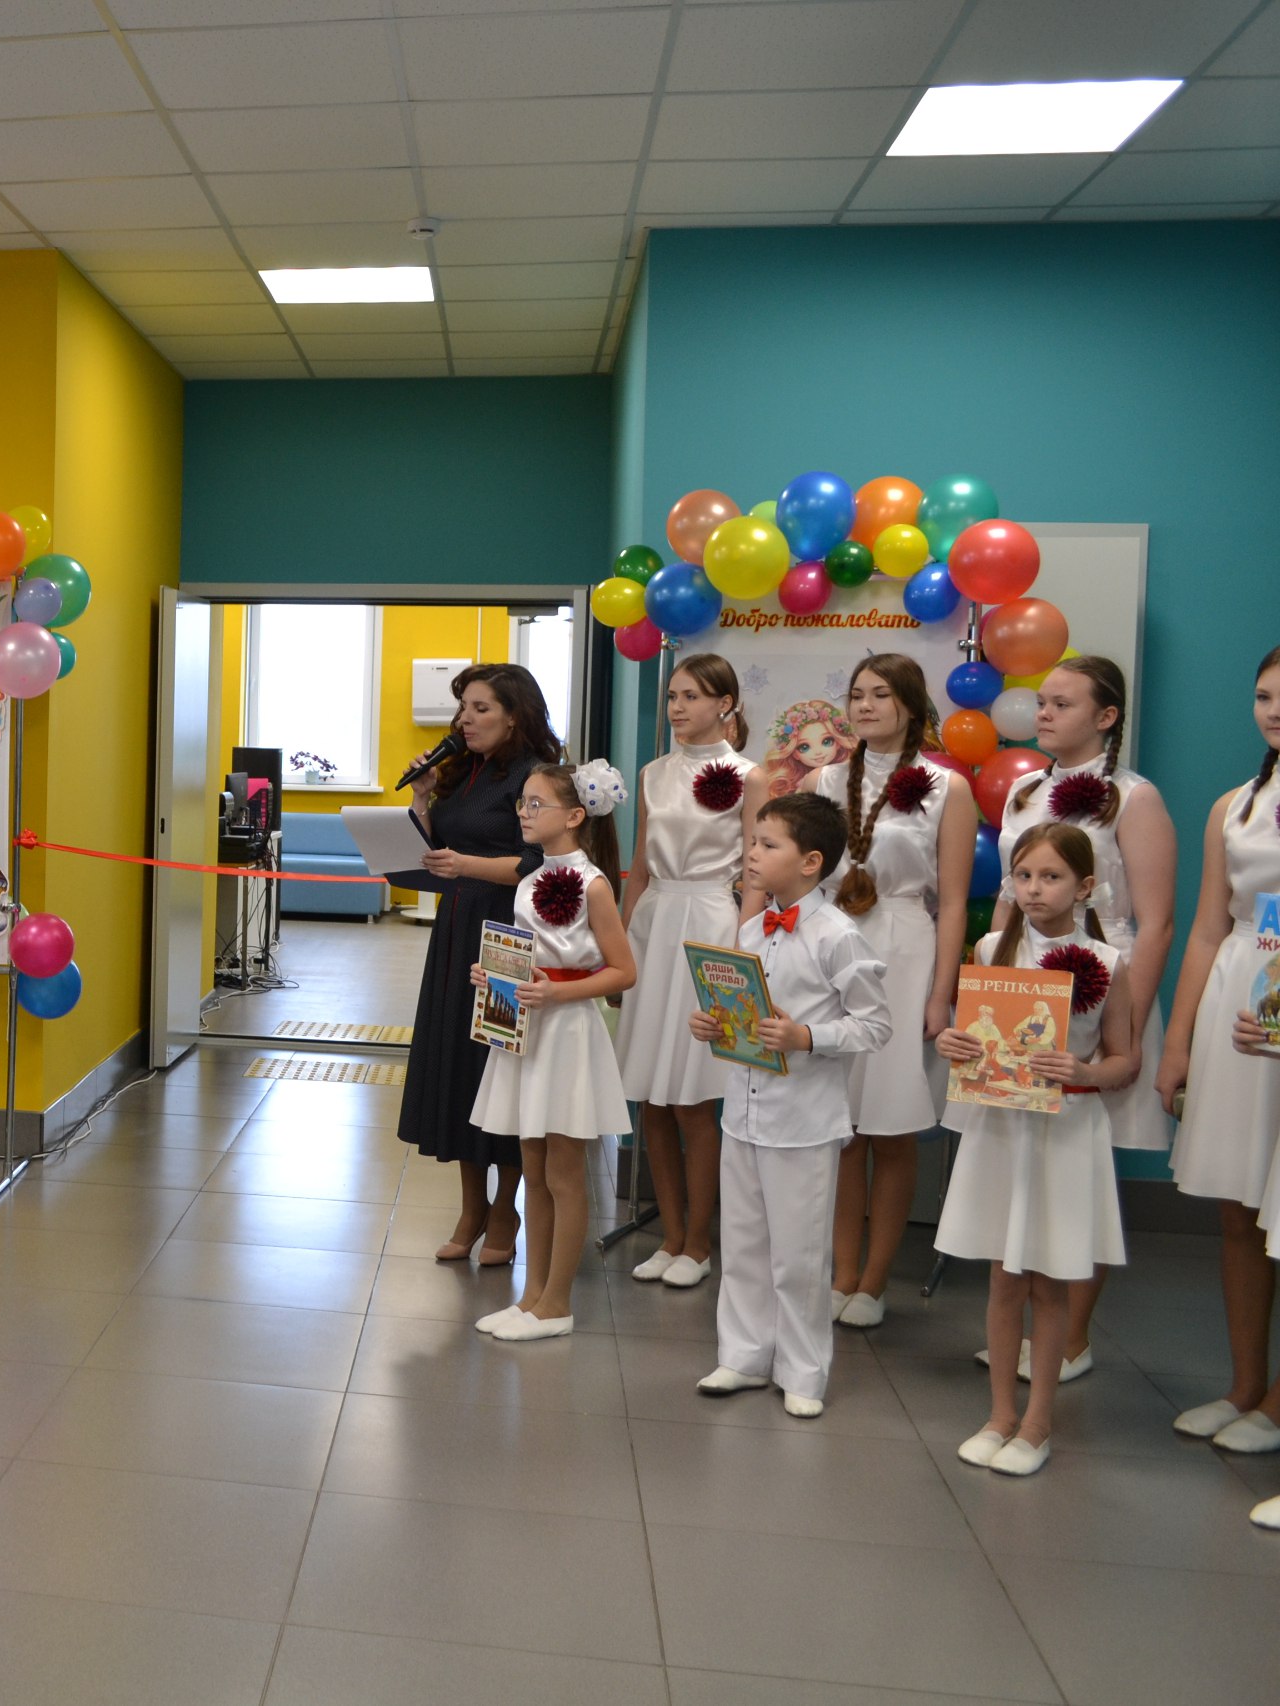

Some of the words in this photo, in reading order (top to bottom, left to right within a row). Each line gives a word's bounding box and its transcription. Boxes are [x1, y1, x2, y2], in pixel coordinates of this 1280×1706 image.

[719, 608, 783, 633] Добро
[783, 608, 921, 628] пожаловать
[704, 963, 734, 975] ВАШИ
[709, 974, 745, 987] ПРАВА!
[983, 979, 1042, 996] РЕПКА
